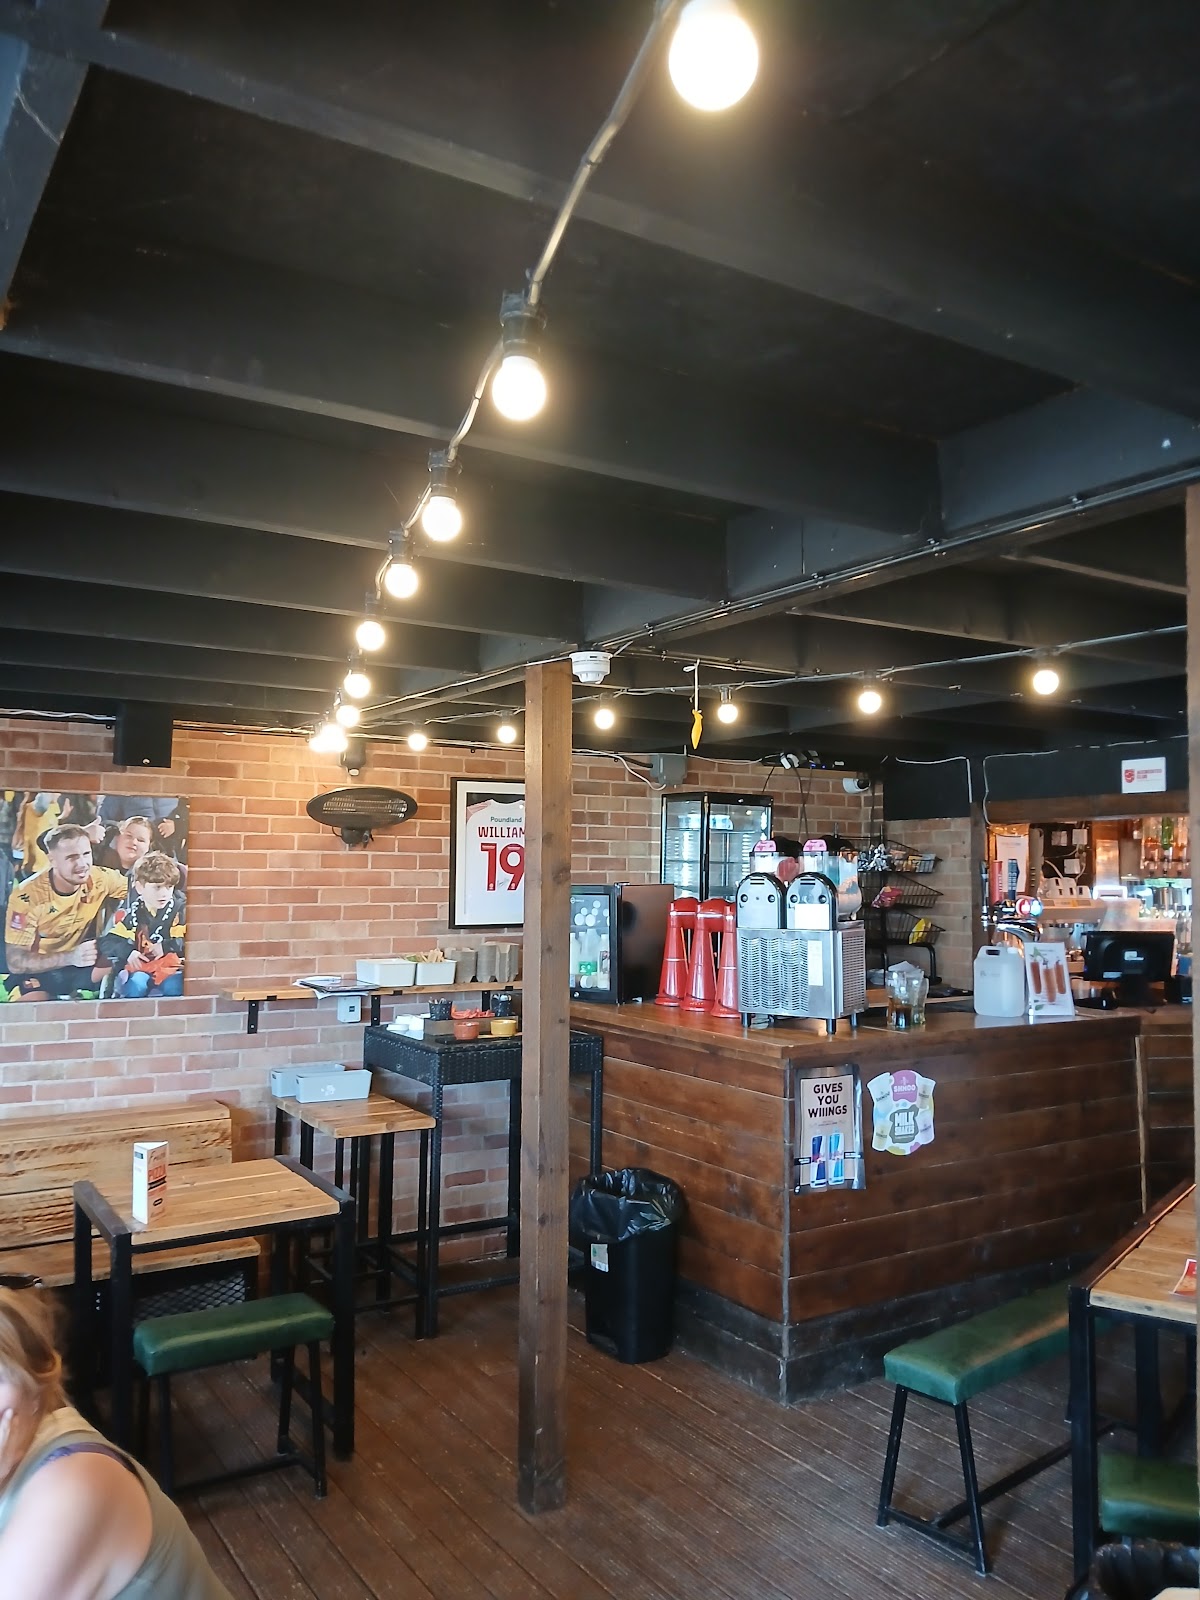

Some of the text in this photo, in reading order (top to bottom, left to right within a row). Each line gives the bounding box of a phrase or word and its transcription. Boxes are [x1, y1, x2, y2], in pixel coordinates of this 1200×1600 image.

[480, 842, 525, 891] 19
[813, 1082, 843, 1094] GIVES
[817, 1094, 839, 1105] YOU
[807, 1104, 848, 1118] WIIINGS
[894, 1111, 915, 1126] MILK
